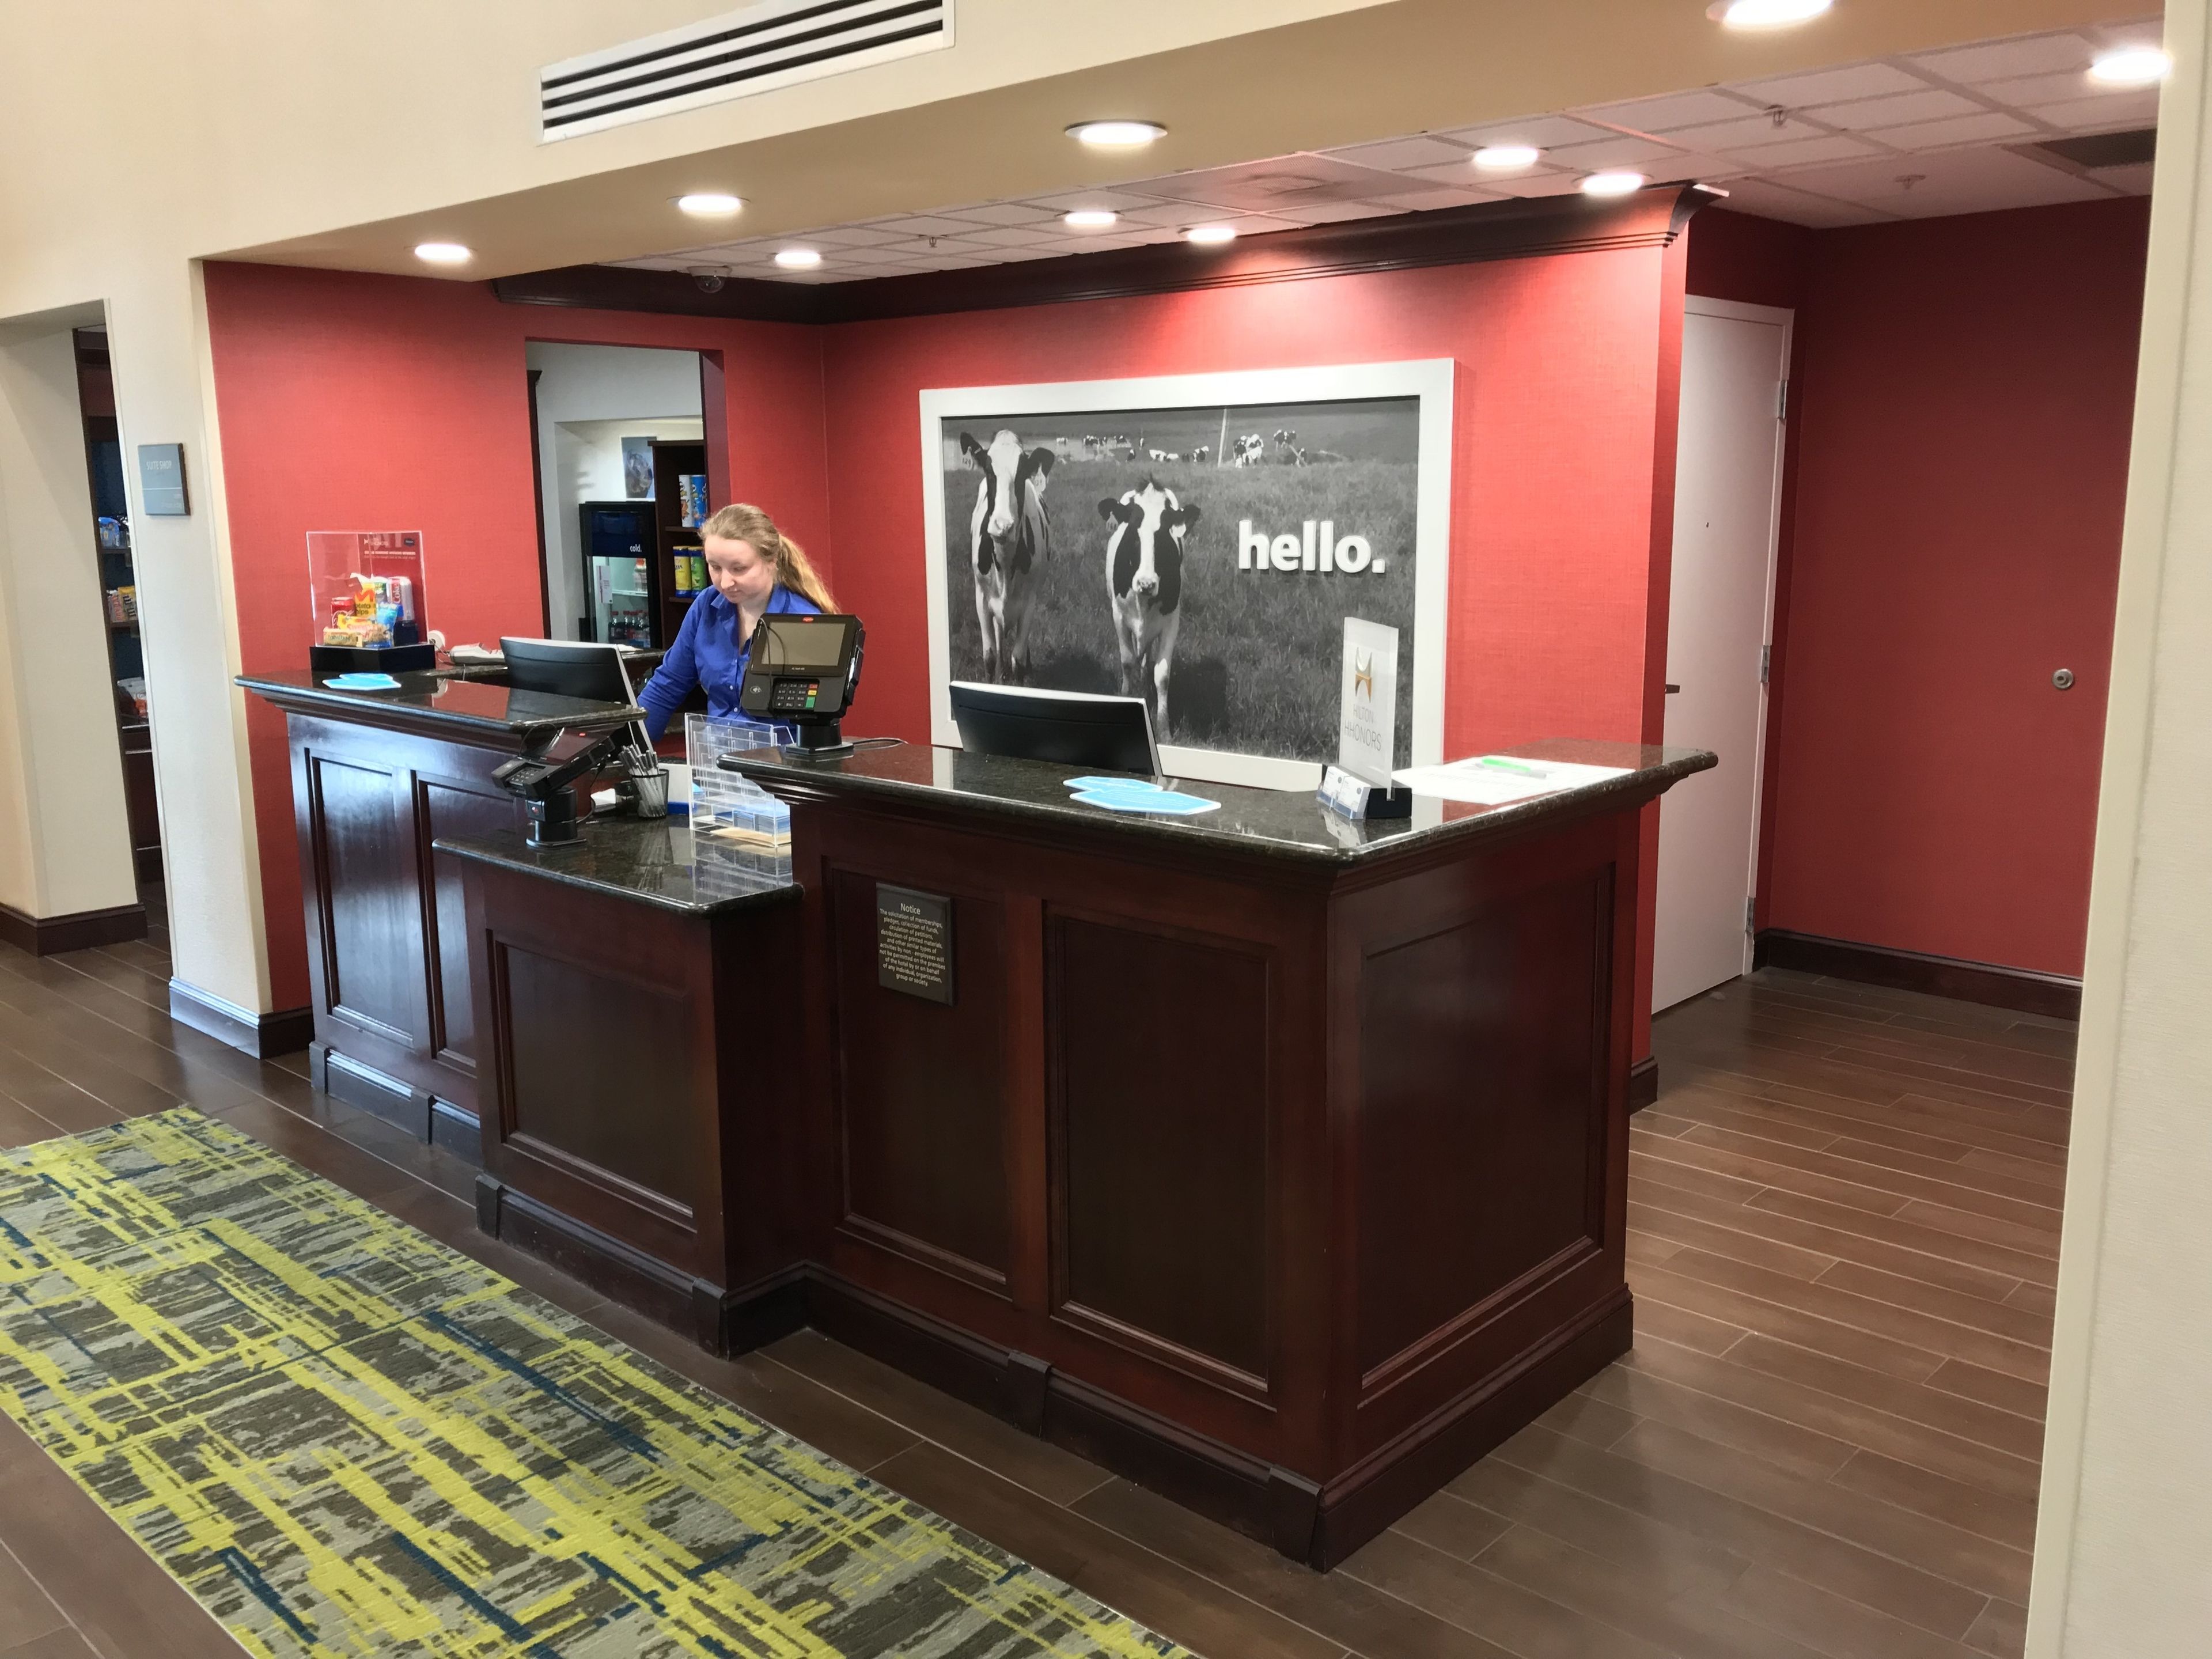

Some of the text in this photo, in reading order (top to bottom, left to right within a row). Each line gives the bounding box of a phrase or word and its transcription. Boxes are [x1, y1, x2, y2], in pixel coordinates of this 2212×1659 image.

[1238, 520, 1385, 574] hello.
[1353, 704, 1374, 724] HILTON
[1344, 719, 1381, 751] HHONORS
[900, 903, 921, 915] Notice
